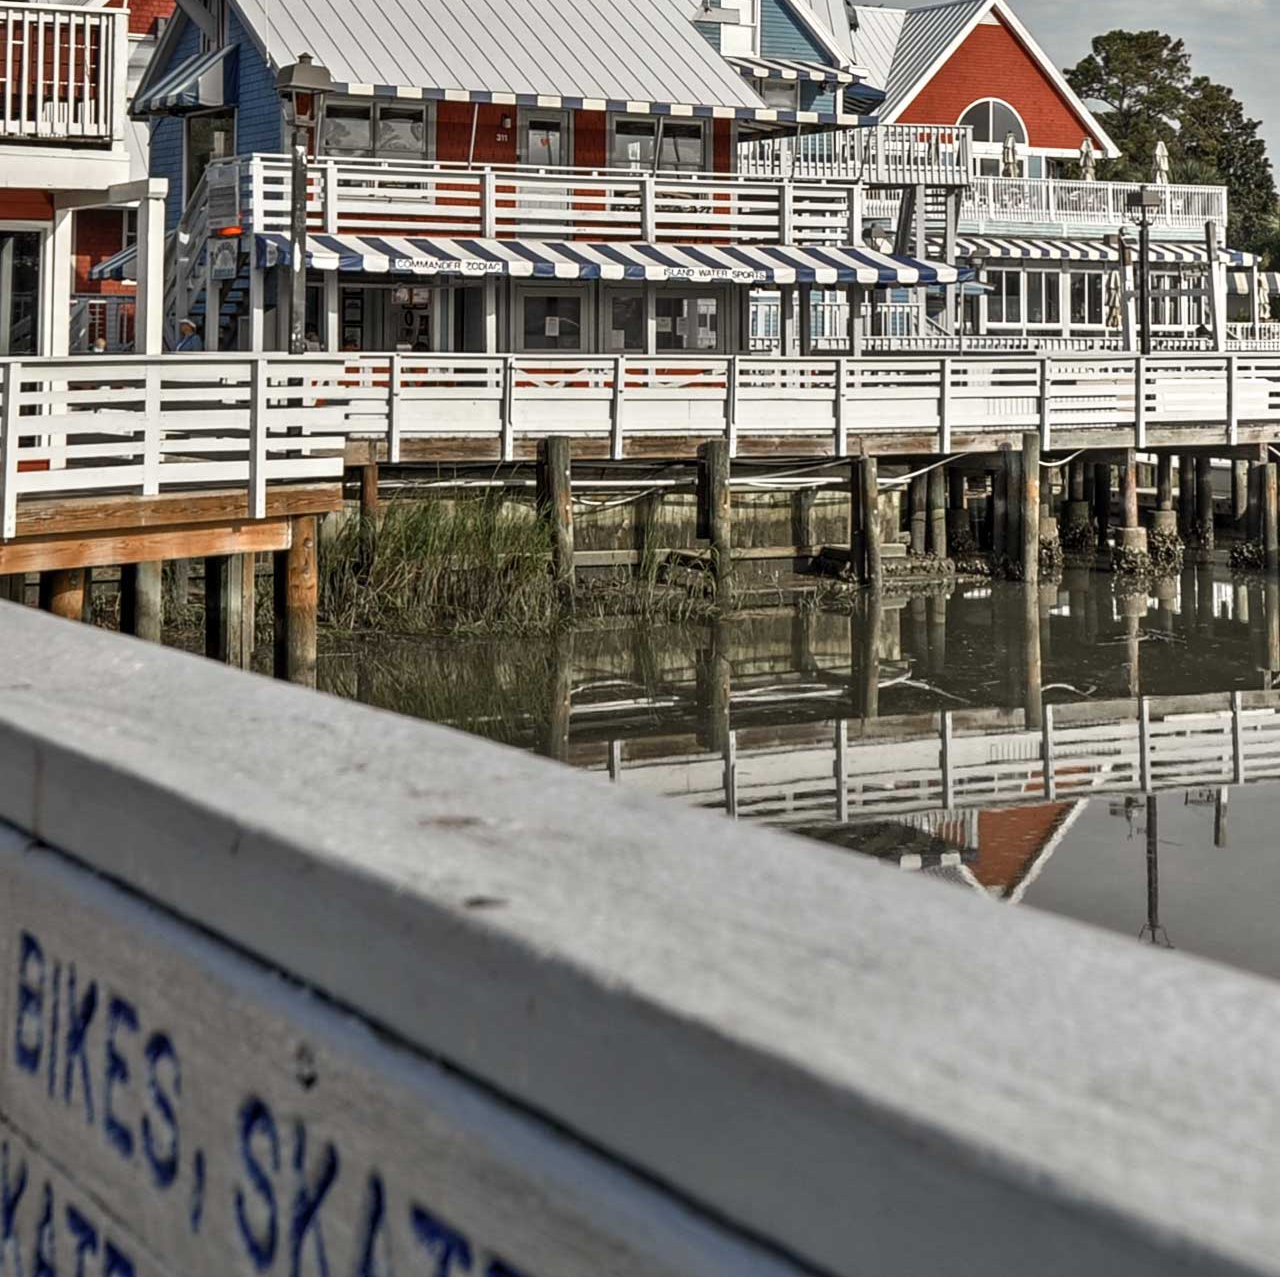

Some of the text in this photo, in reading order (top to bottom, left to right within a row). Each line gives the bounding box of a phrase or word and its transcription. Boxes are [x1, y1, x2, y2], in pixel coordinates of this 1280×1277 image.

[397, 260, 501, 272] COMMANDER ZODIAC
[663, 268, 767, 279] ISLAND WATER SPORTS
[16, 929, 207, 1235] BIKES,
